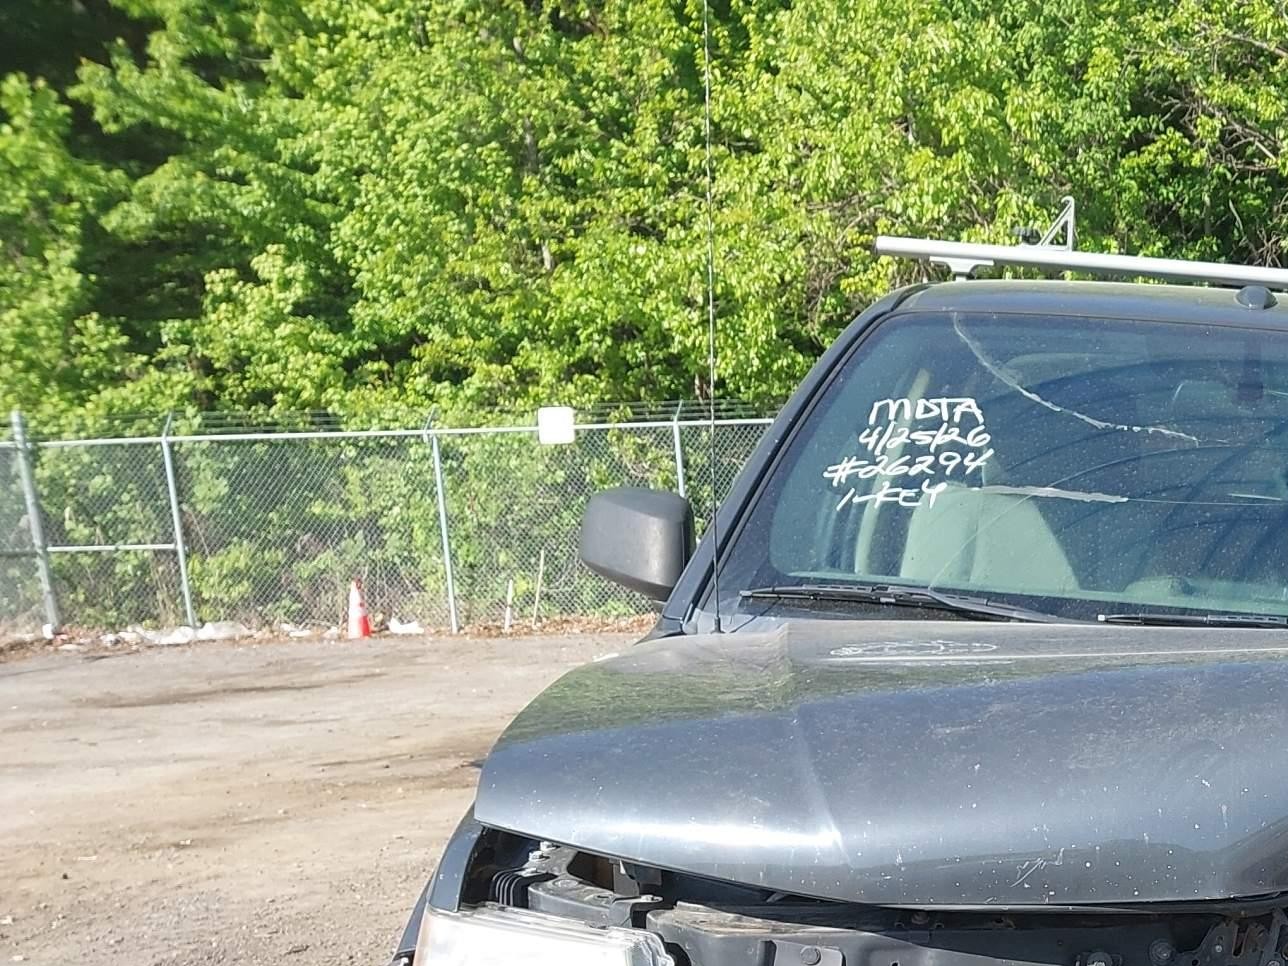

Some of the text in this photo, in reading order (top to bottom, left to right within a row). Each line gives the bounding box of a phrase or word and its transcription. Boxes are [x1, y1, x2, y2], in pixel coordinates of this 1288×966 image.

[868, 397, 985, 425] MDTA
[858, 421, 992, 455] 4/25/26
[823, 447, 995, 487] #26294
